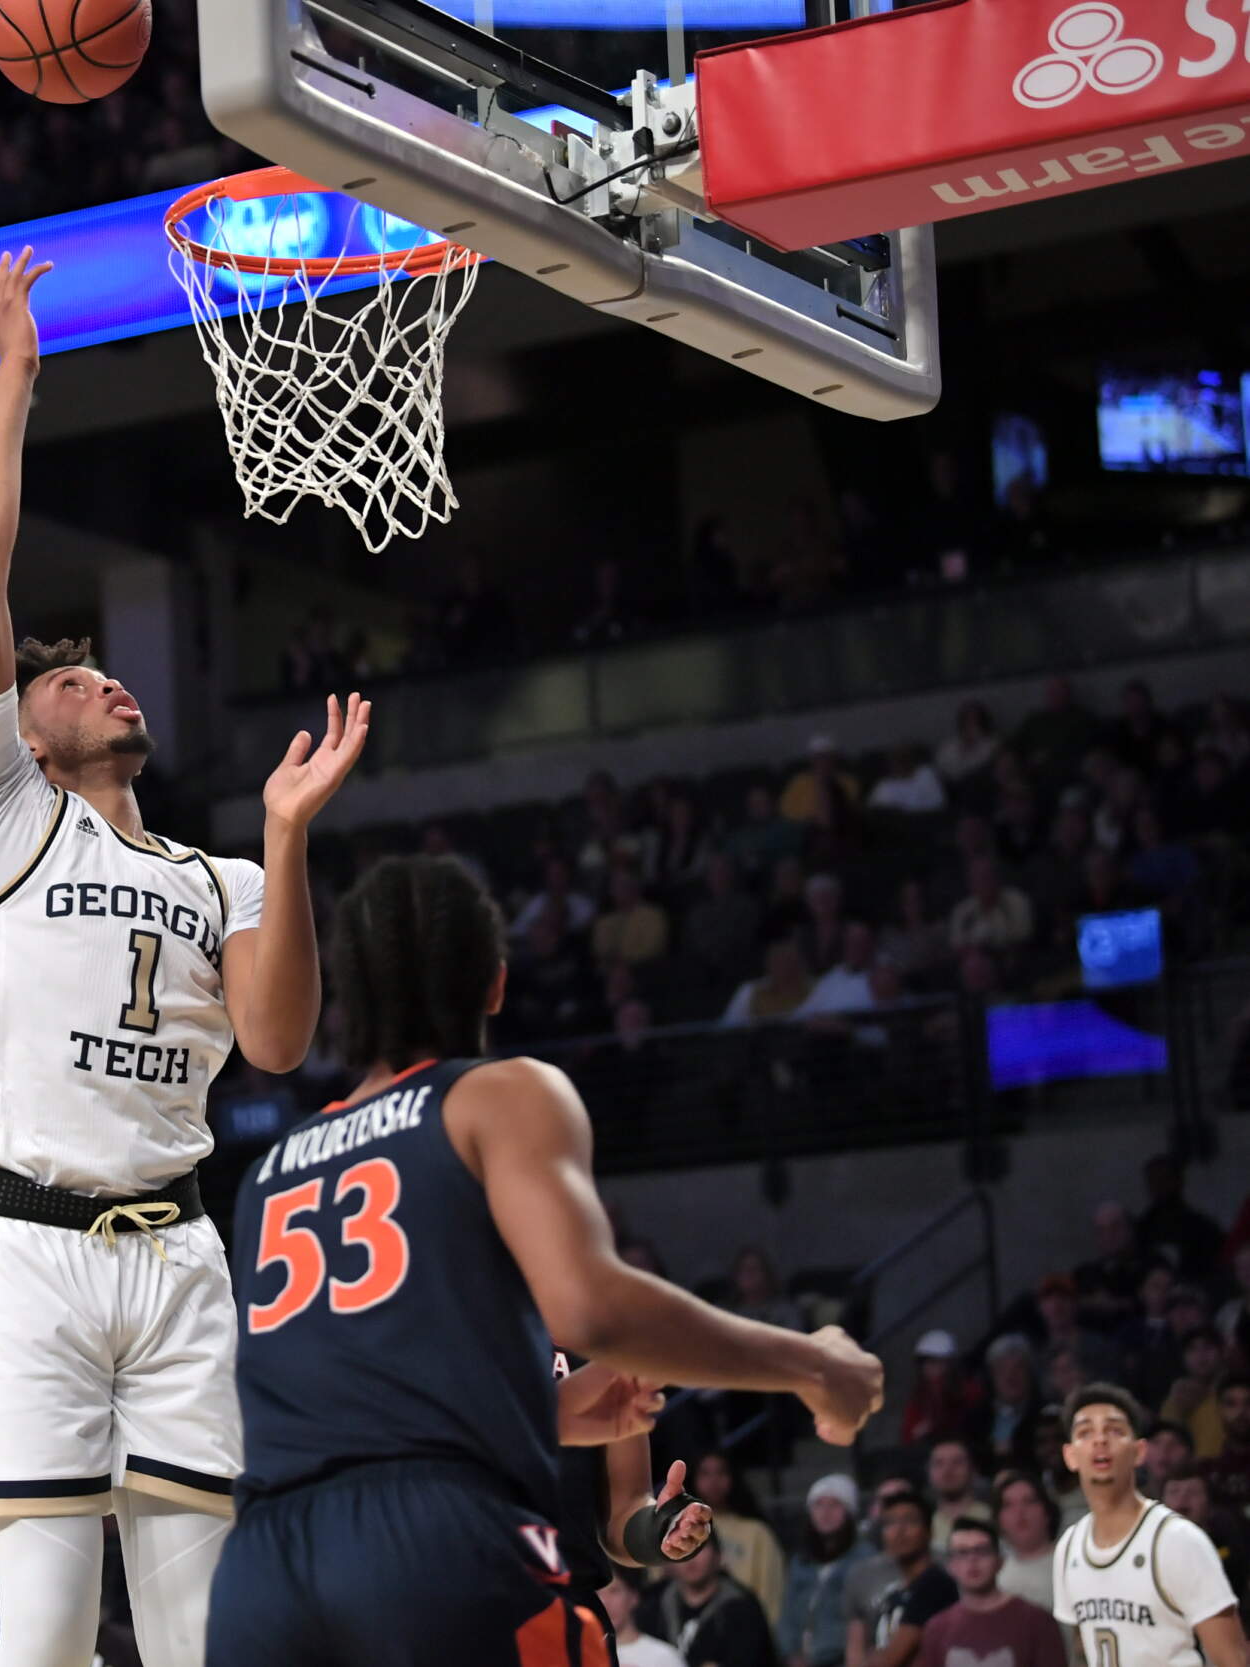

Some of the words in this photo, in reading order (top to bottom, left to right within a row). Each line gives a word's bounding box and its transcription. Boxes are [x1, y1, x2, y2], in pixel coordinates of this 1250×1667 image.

[1177, 0, 1250, 78] S
[930, 134, 1185, 205] Farm
[118, 928, 163, 1035] 1
[70, 1030, 191, 1084] TECH
[248, 1156, 410, 1335] 53
[552, 1351, 571, 1379] A
